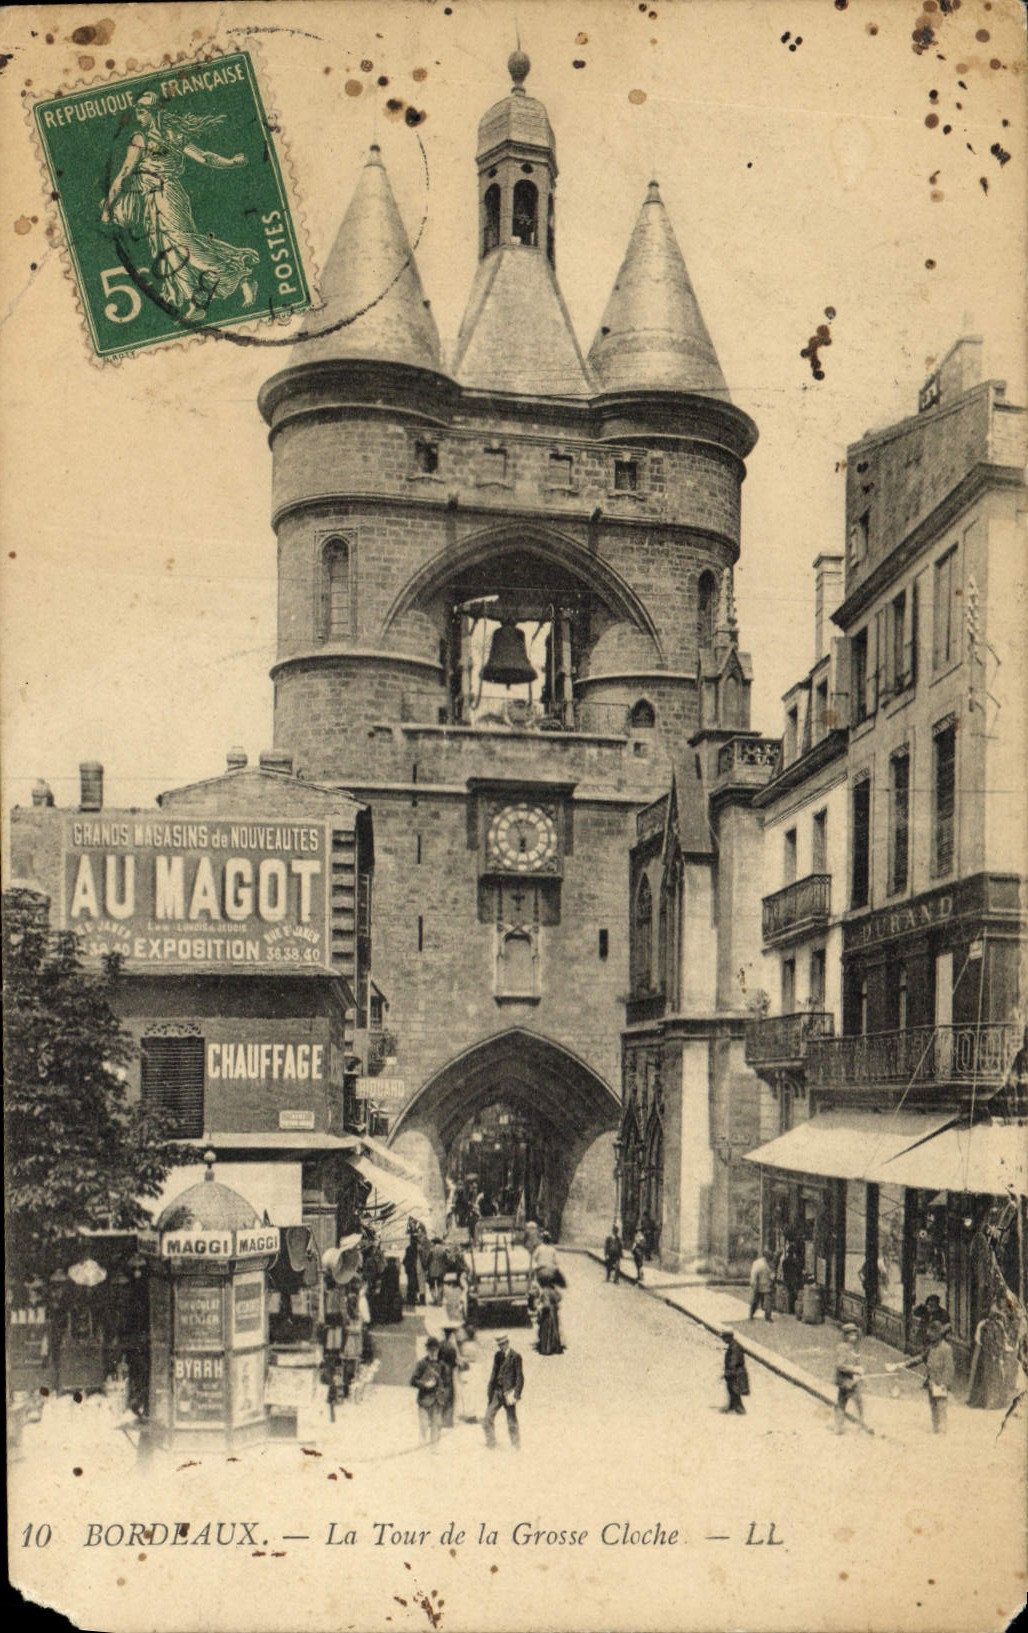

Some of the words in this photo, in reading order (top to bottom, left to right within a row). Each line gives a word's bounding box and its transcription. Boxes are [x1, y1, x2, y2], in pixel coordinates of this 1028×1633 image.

[160, 63, 245, 98] FRANÇAISE
[261, 210, 297, 295] POSTES
[73, 823, 129, 846] GRANDS
[134, 825, 208, 849] MAGASINS
[211, 828, 229, 849] de
[69, 853, 136, 921] AU
[154, 854, 322, 923] MAGOT
[133, 937, 260, 960] EXPOSITION
[207, 1043, 324, 1080] CHAUFFAGE
[166, 1239, 229, 1255] MAGGI
[238, 1235, 279, 1254] MAGGI
[175, 1359, 224, 1379] BYRRH
